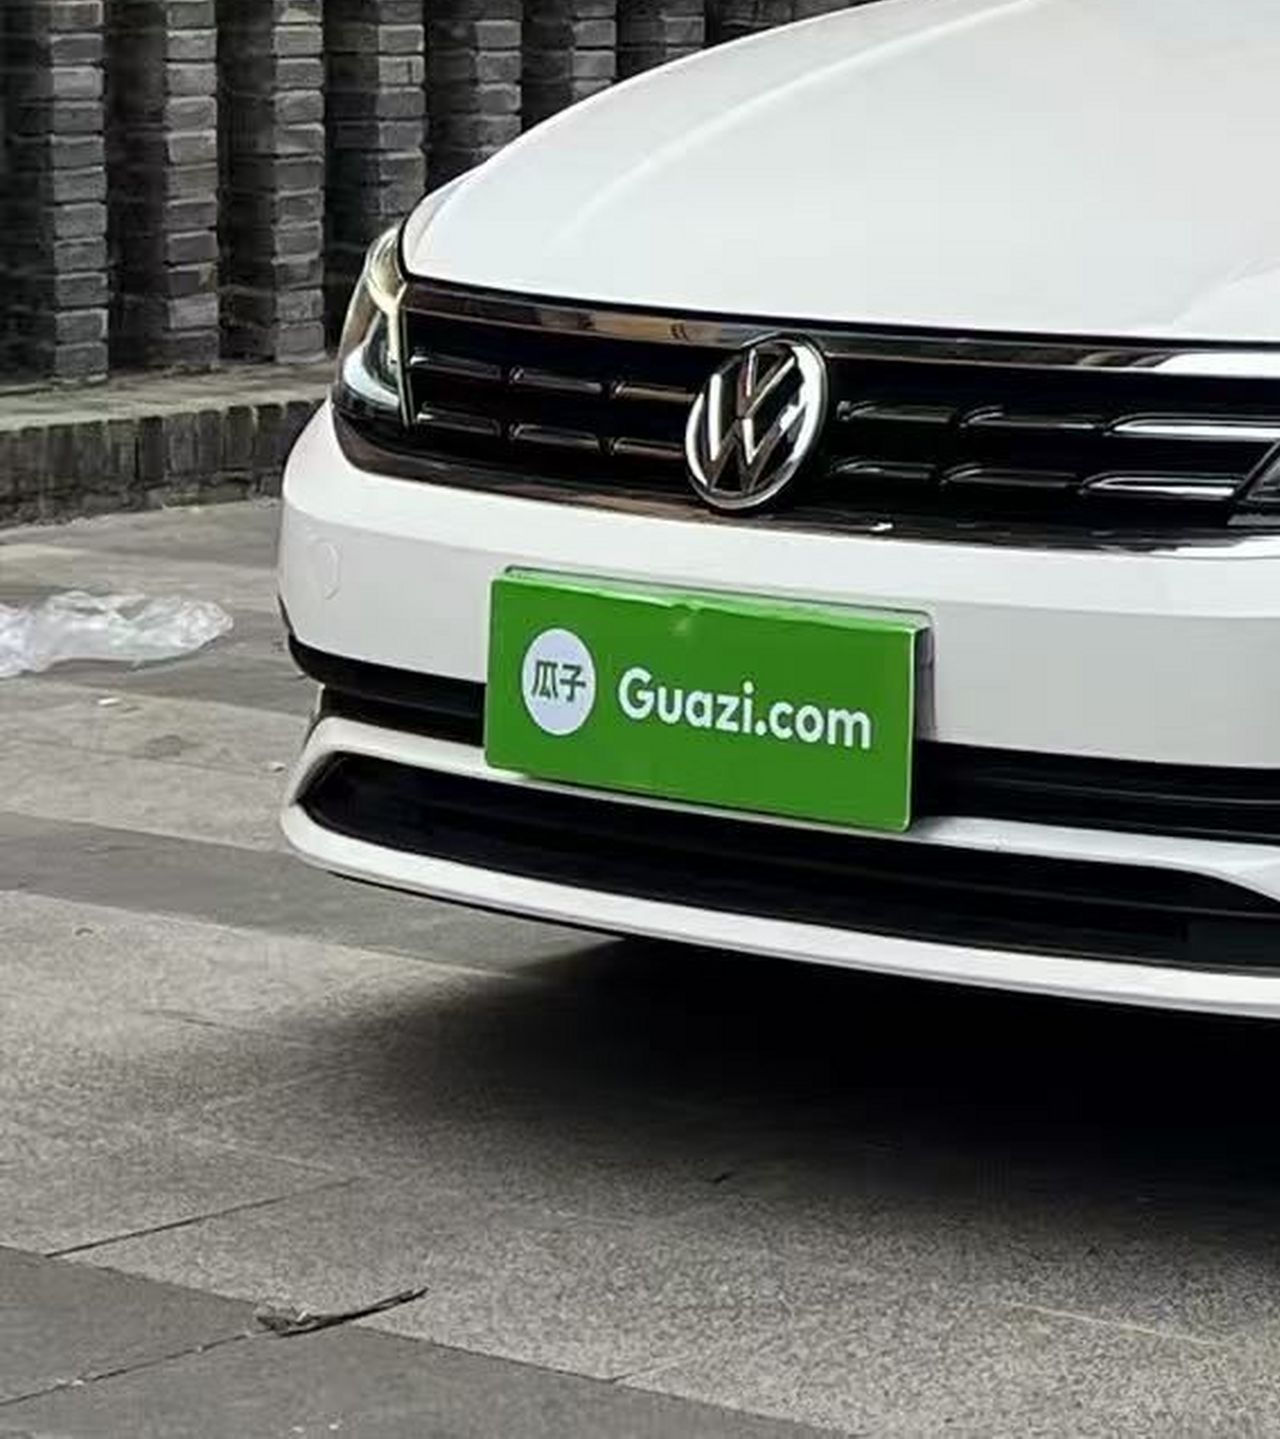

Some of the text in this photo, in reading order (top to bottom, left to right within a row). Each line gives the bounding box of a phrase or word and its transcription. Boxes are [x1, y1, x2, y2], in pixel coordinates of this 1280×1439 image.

[692, 337, 818, 502] VW
[531, 660, 587, 702] 瓜子
[617, 666, 872, 750] Guazi.com
